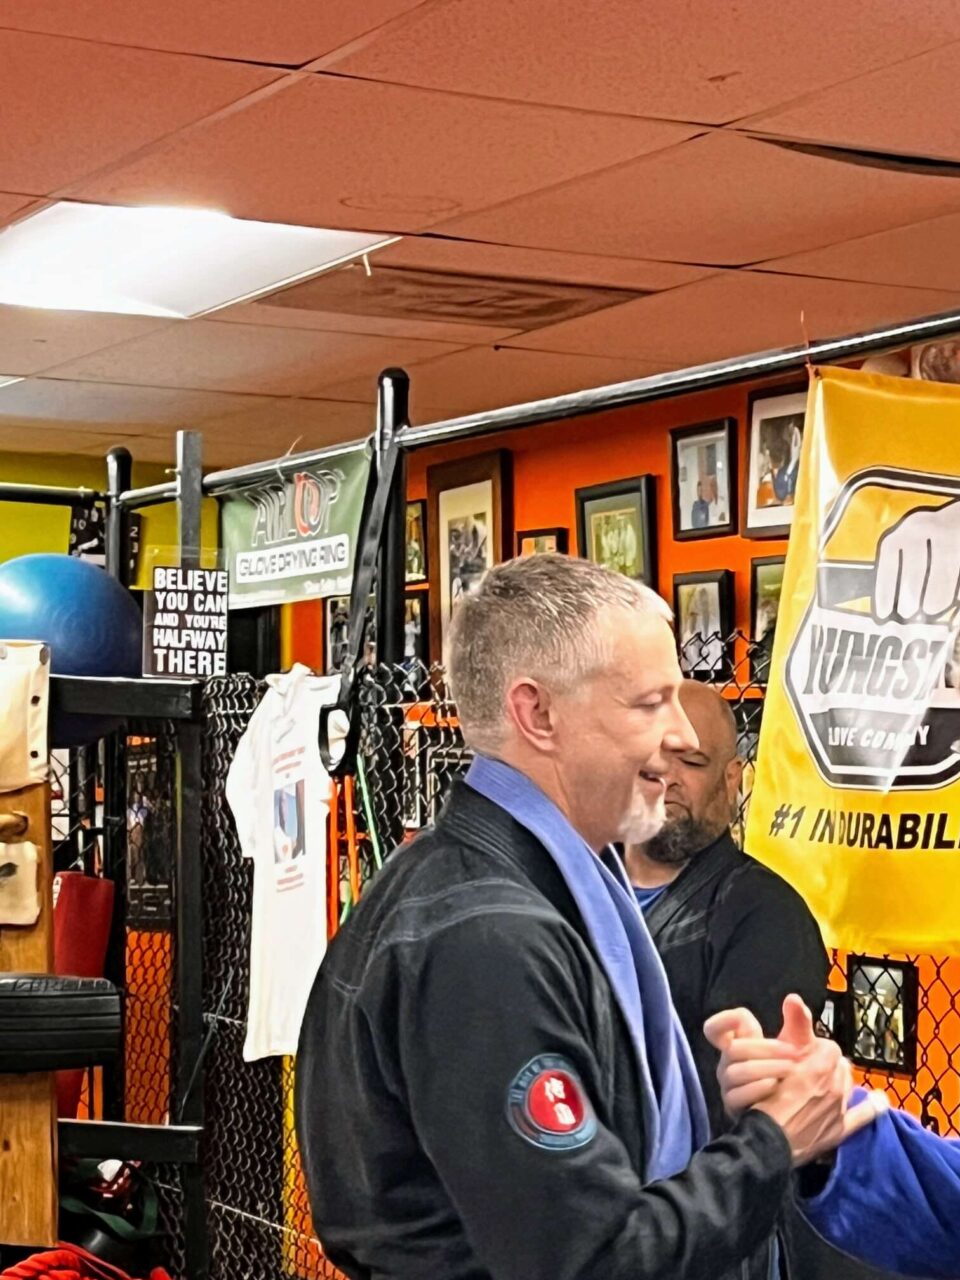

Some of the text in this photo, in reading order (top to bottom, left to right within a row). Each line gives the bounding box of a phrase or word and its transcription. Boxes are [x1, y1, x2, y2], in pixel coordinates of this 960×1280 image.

[320, 542, 345, 565] RING
[154, 568, 228, 593] BELIEVE
[155, 592, 188, 611] YOU
[193, 593, 228, 613] CAN
[154, 613, 179, 627] AND
[153, 628, 227, 651] HALFWAY
[153, 649, 227, 676] THERE
[769, 803, 807, 839] #1
